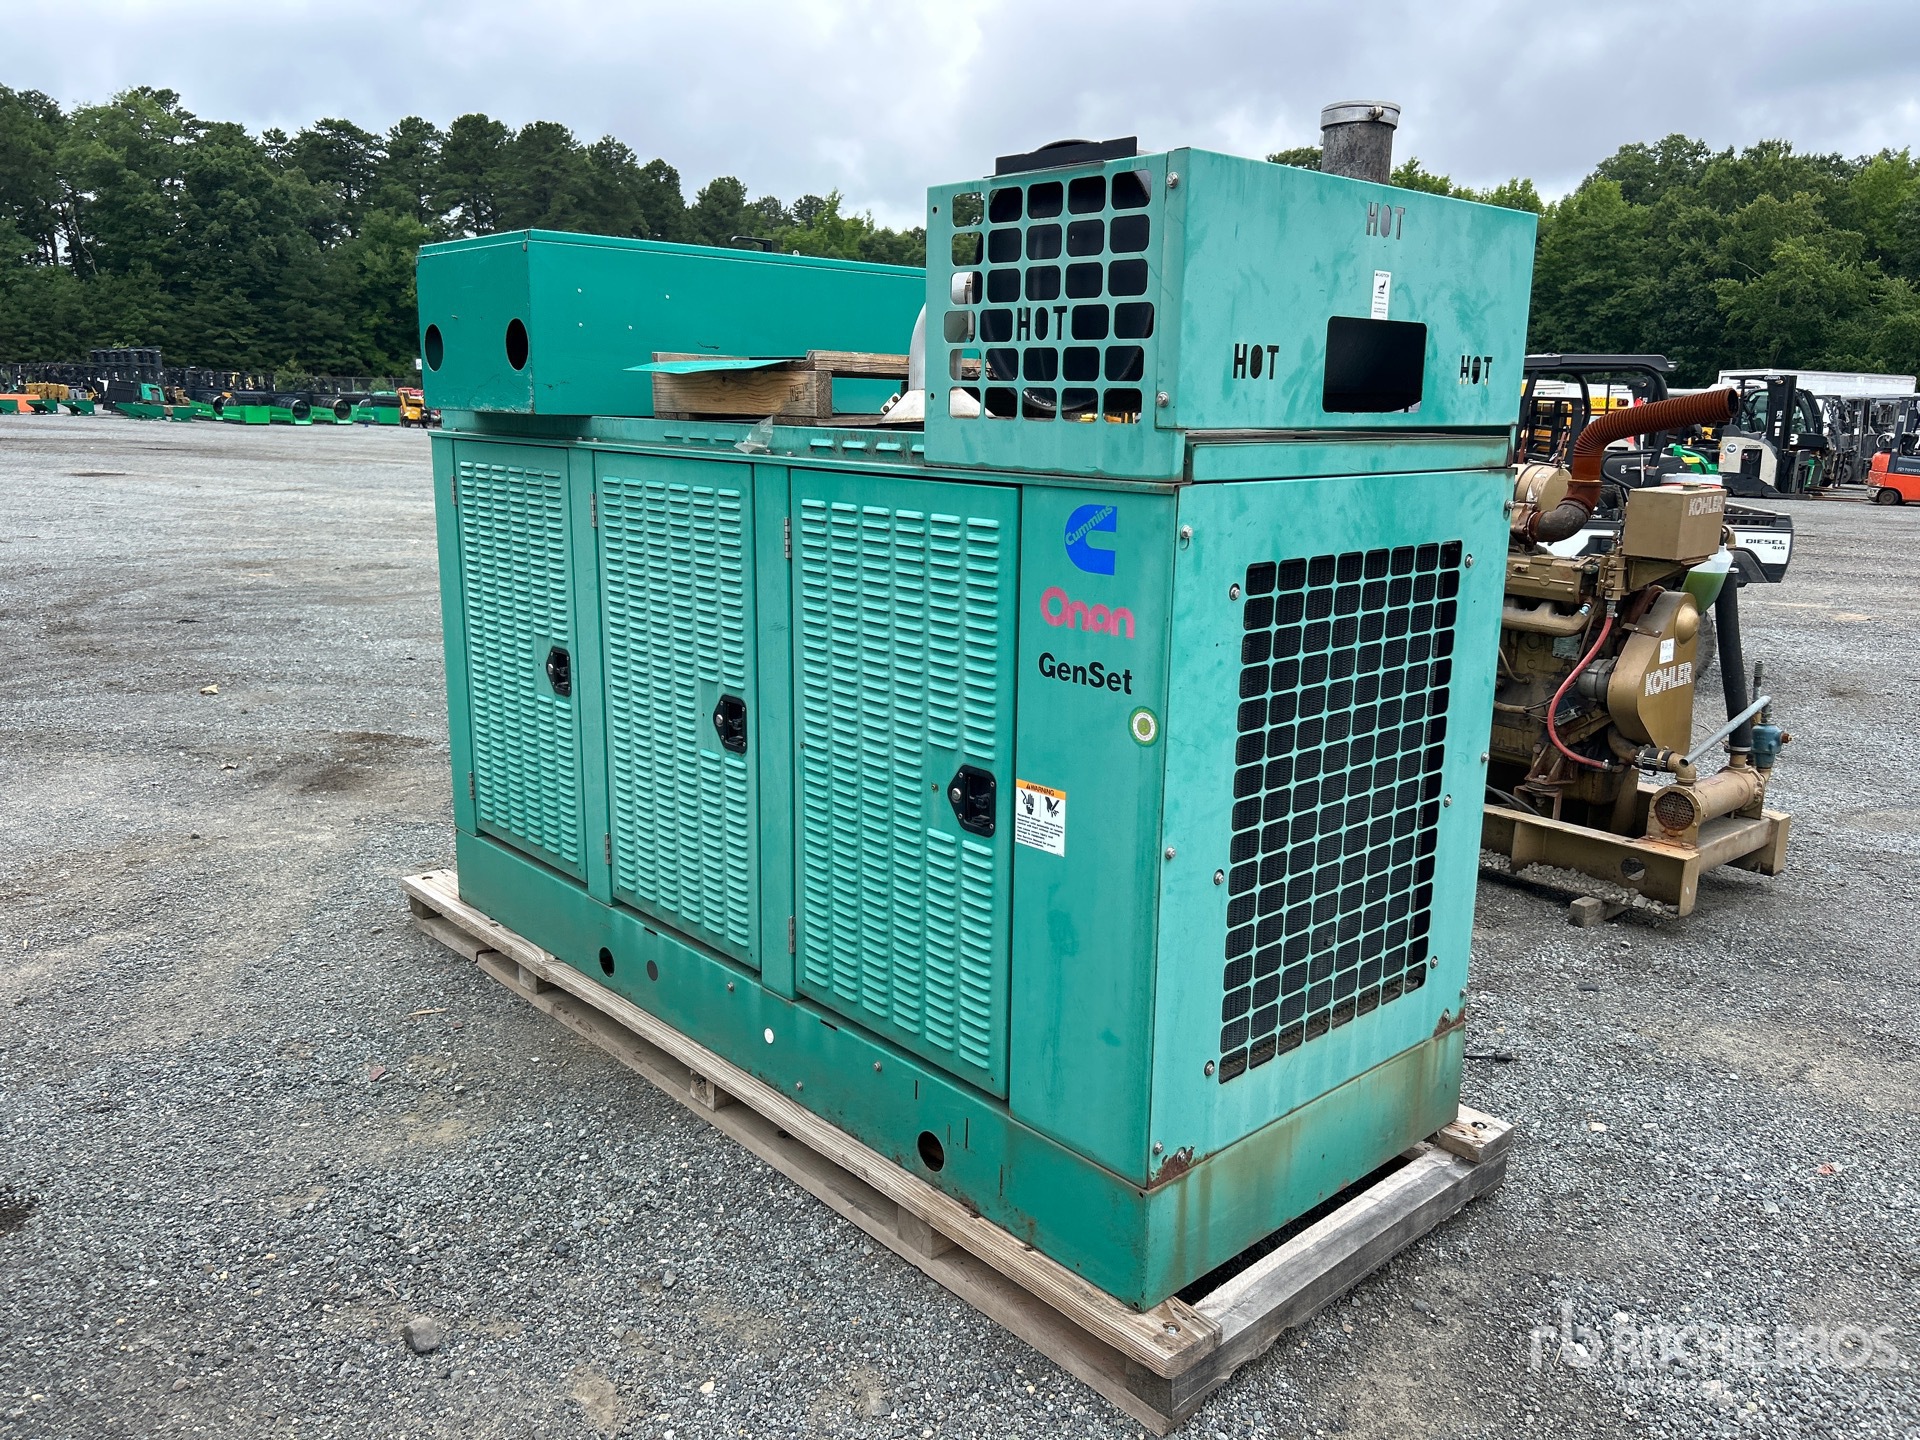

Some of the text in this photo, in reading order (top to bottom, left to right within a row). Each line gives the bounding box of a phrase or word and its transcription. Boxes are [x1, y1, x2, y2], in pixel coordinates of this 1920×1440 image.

[1366, 202, 1405, 240] HOT
[1016, 305, 1068, 341] HOT
[1233, 343, 1280, 380] HOT
[1460, 355, 1493, 386] HOT
[1688, 495, 1723, 517] KOHLER
[1065, 505, 1114, 547] Cummins
[1041, 586, 1135, 640] Onan
[1038, 652, 1132, 695] GenSet
[1645, 661, 1692, 697] KOHLER
[1030, 784, 1055, 796] WARNING
